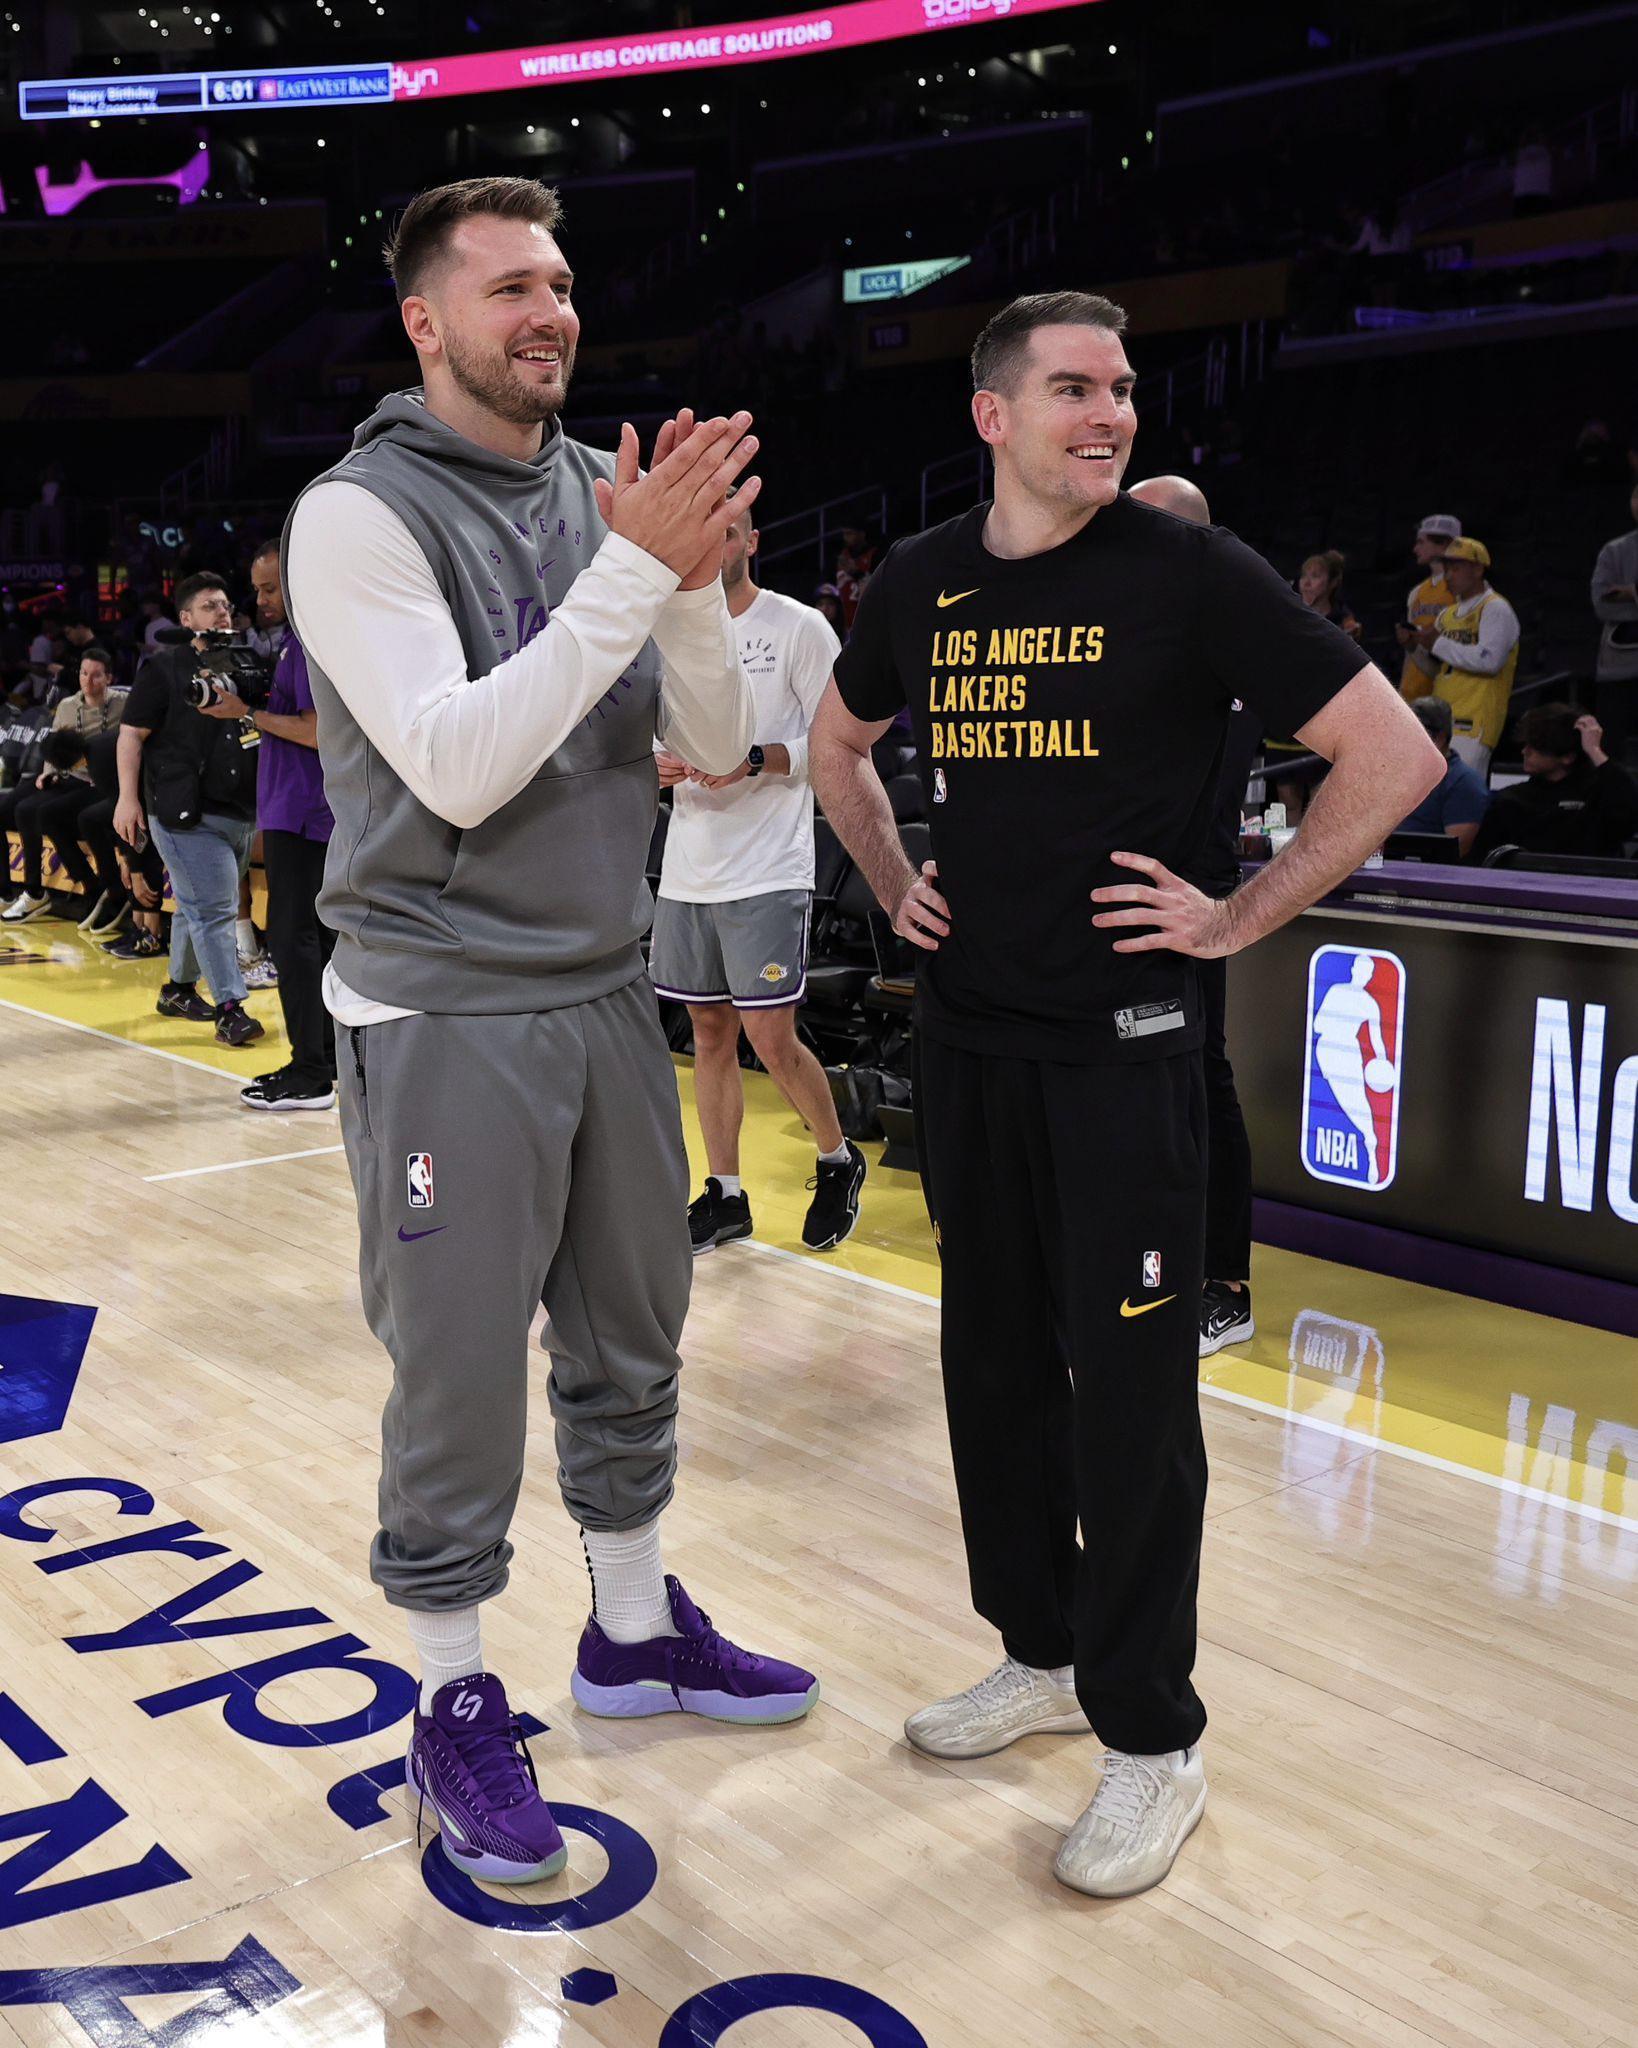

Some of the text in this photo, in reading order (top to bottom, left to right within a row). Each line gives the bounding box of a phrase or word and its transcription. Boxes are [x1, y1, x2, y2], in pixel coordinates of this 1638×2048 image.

[520, 20, 833, 77] WIRELESS COVERAGE SOLUTIONS
[107, 86, 158, 102] Birthday
[213, 80, 254, 101] 6:01
[931, 626, 1104, 666] LOS ANGELES
[929, 675, 1027, 712] LAKERS
[931, 719, 1099, 758] BASKETBALL
[1315, 1126, 1358, 1170] NBA
